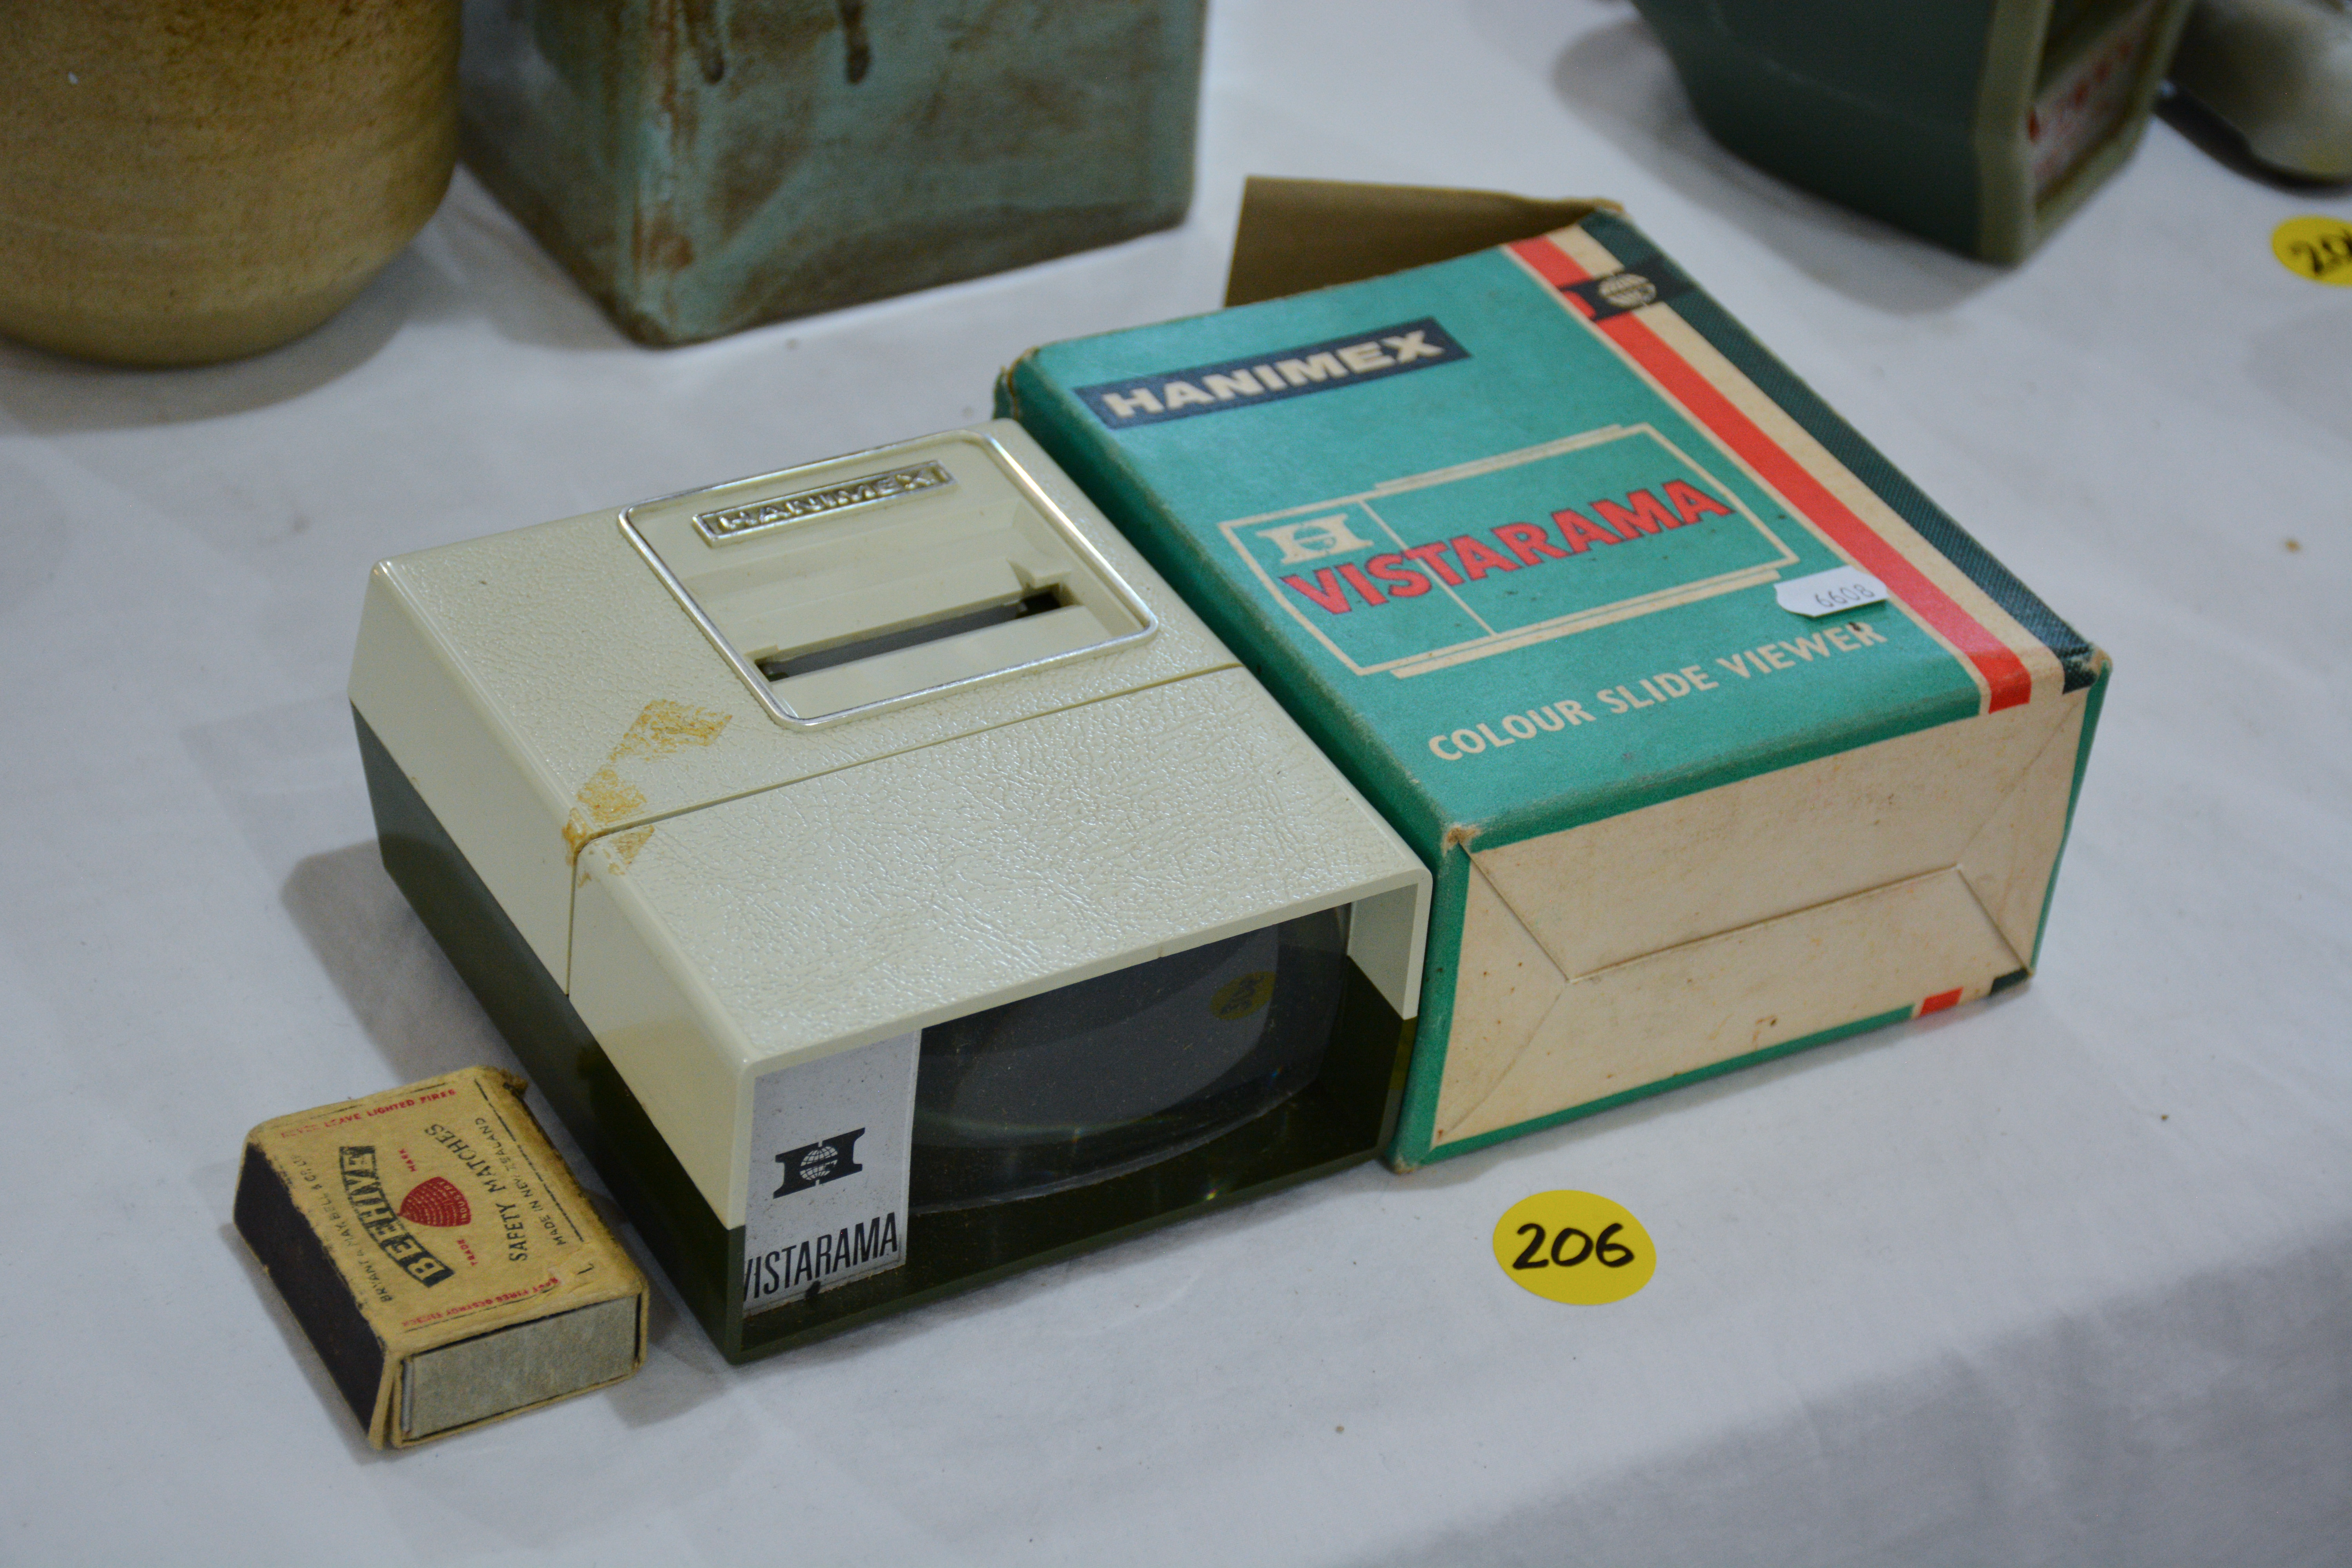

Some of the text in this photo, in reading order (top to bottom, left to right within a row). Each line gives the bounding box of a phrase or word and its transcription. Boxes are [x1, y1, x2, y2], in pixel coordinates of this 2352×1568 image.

[2289, 227, 2352, 276] 20
[1102, 330, 1446, 419] HANIMEX
[718, 473, 936, 530] HANIMEX
[1279, 478, 1736, 615] VISTARAMA
[1814, 584, 1875, 608] 6608
[1428, 621, 1887, 761] COLOUR SLIDE VIEWER
[323, 1113, 361, 1128] LEAVE
[367, 1099, 415, 1117] LIGHTED
[420, 1089, 457, 1104] FIRES
[398, 1148, 417, 1172] MARK
[475, 1118, 517, 1171] ZEALAND
[343, 1153, 445, 1279] BEEHIVE
[425, 1124, 528, 1261] SAFETY MATCHES
[437, 1180, 468, 1222] INDUSTRY
[529, 1200, 543, 1212] IN
[457, 1239, 479, 1267] TRADE
[539, 1215, 566, 1246] MADE
[1512, 1223, 1635, 1270] 206
[495, 1289, 529, 1302] FIRES
